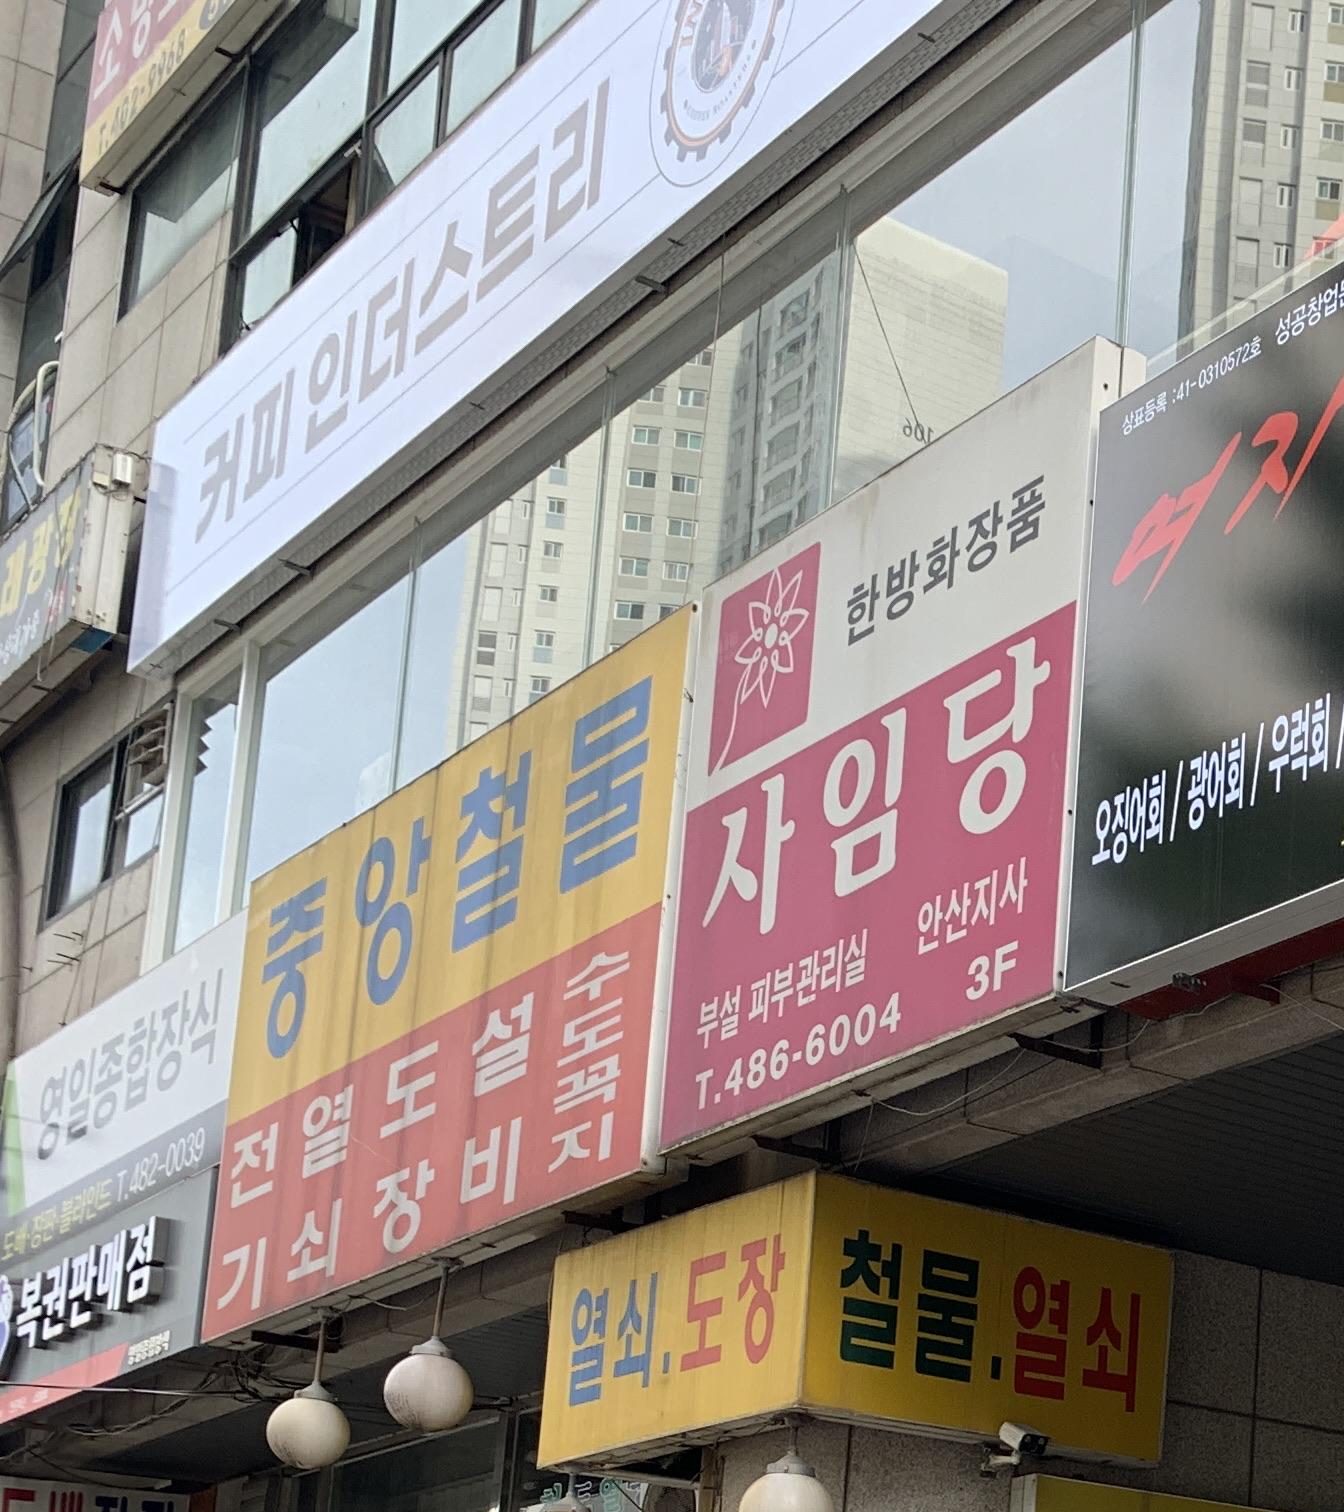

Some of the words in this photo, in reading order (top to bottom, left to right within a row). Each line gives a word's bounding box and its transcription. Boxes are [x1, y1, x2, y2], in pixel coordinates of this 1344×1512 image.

[194, 369, 296, 546] 커피
[304, 78, 611, 455] 인더스트리
[1120, 391, 1169, 436] 상표등록
[846, 475, 1047, 647] 한방화장품
[702, 636, 1051, 936] 사임당
[1187, 732, 1247, 832] 광어회
[1268, 691, 1332, 794] 우럭회
[261, 675, 653, 1059] 중앙철물
[916, 856, 1029, 955] 안산지사
[36, 968, 224, 1160] 영일종합장식
[694, 992, 902, 1110] T.486-6004
[965, 941, 1020, 1002] 3F
[696, 982, 744, 1050] 부설
[748, 927, 869, 1024] 피부관리실
[115, 1127, 206, 1202] T.482-0039
[16, 1215, 158, 1349] 복권판매점
